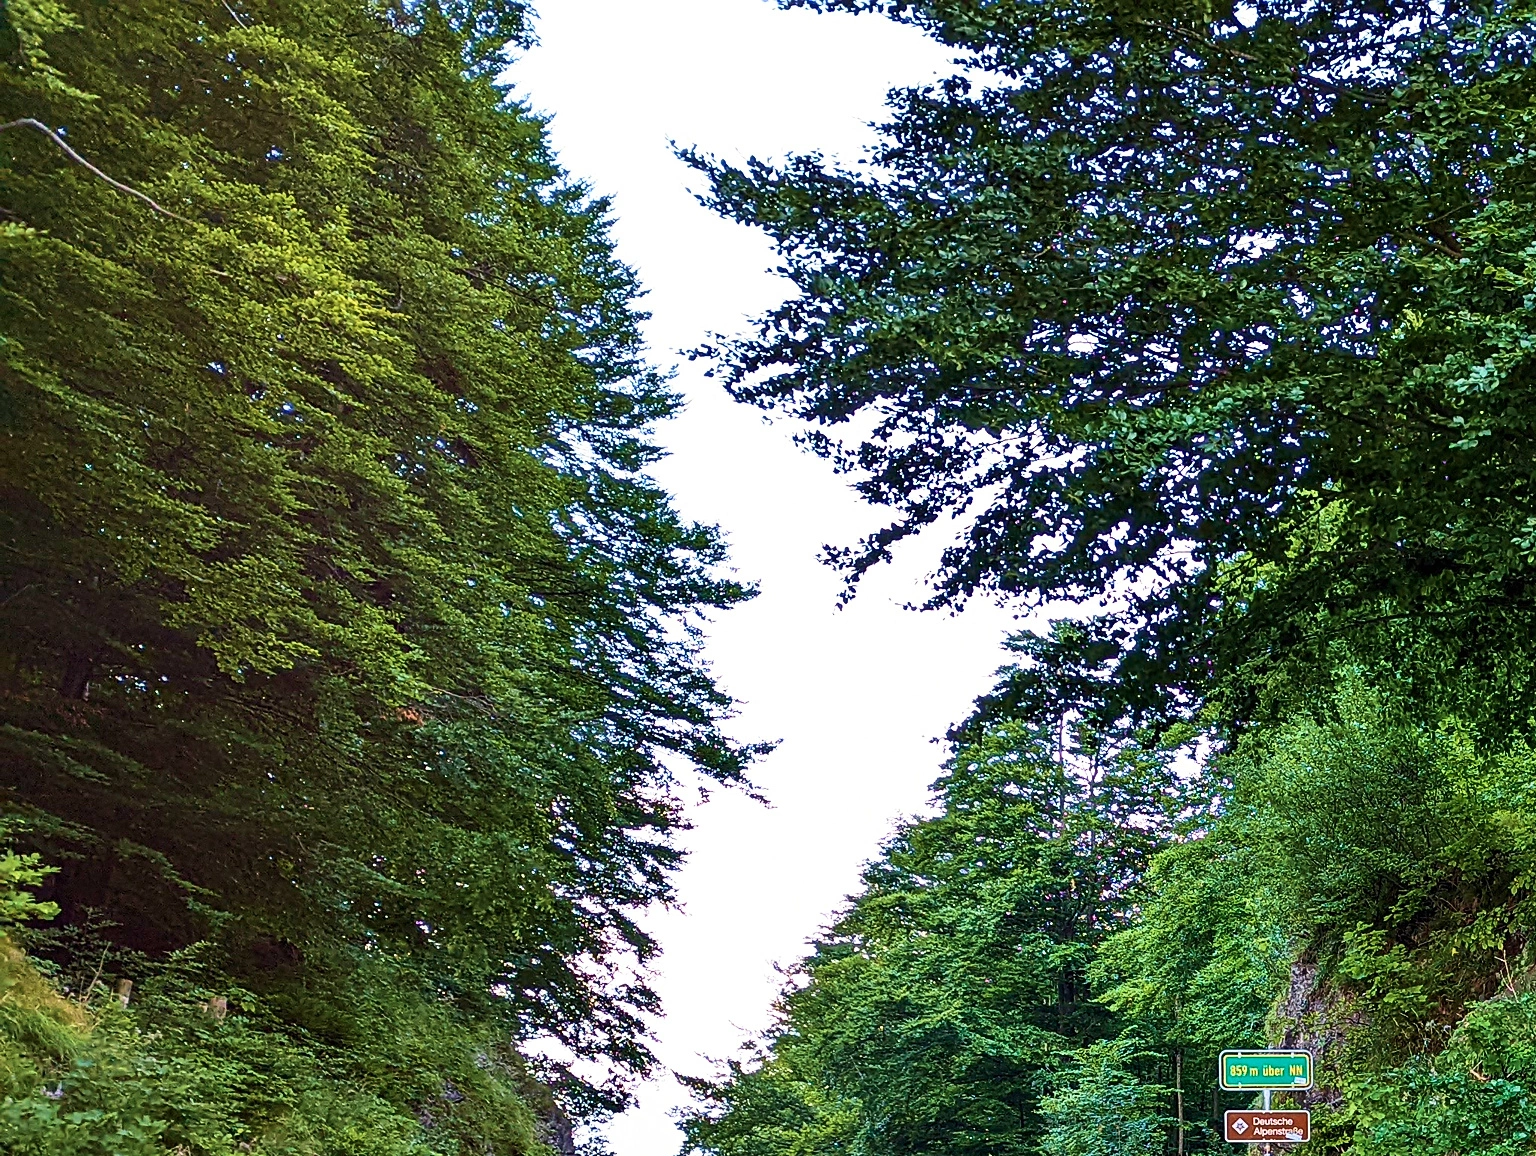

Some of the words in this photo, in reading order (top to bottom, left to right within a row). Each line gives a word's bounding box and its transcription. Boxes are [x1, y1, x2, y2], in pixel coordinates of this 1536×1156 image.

[1229, 1064, 1248, 1077] 859
[1249, 1067, 1259, 1077] m
[1262, 1064, 1285, 1077] über
[1289, 1064, 1303, 1077] NN
[1252, 1117, 1293, 1126] Deutsche
[1252, 1127, 1304, 1137] Alpenstraße
